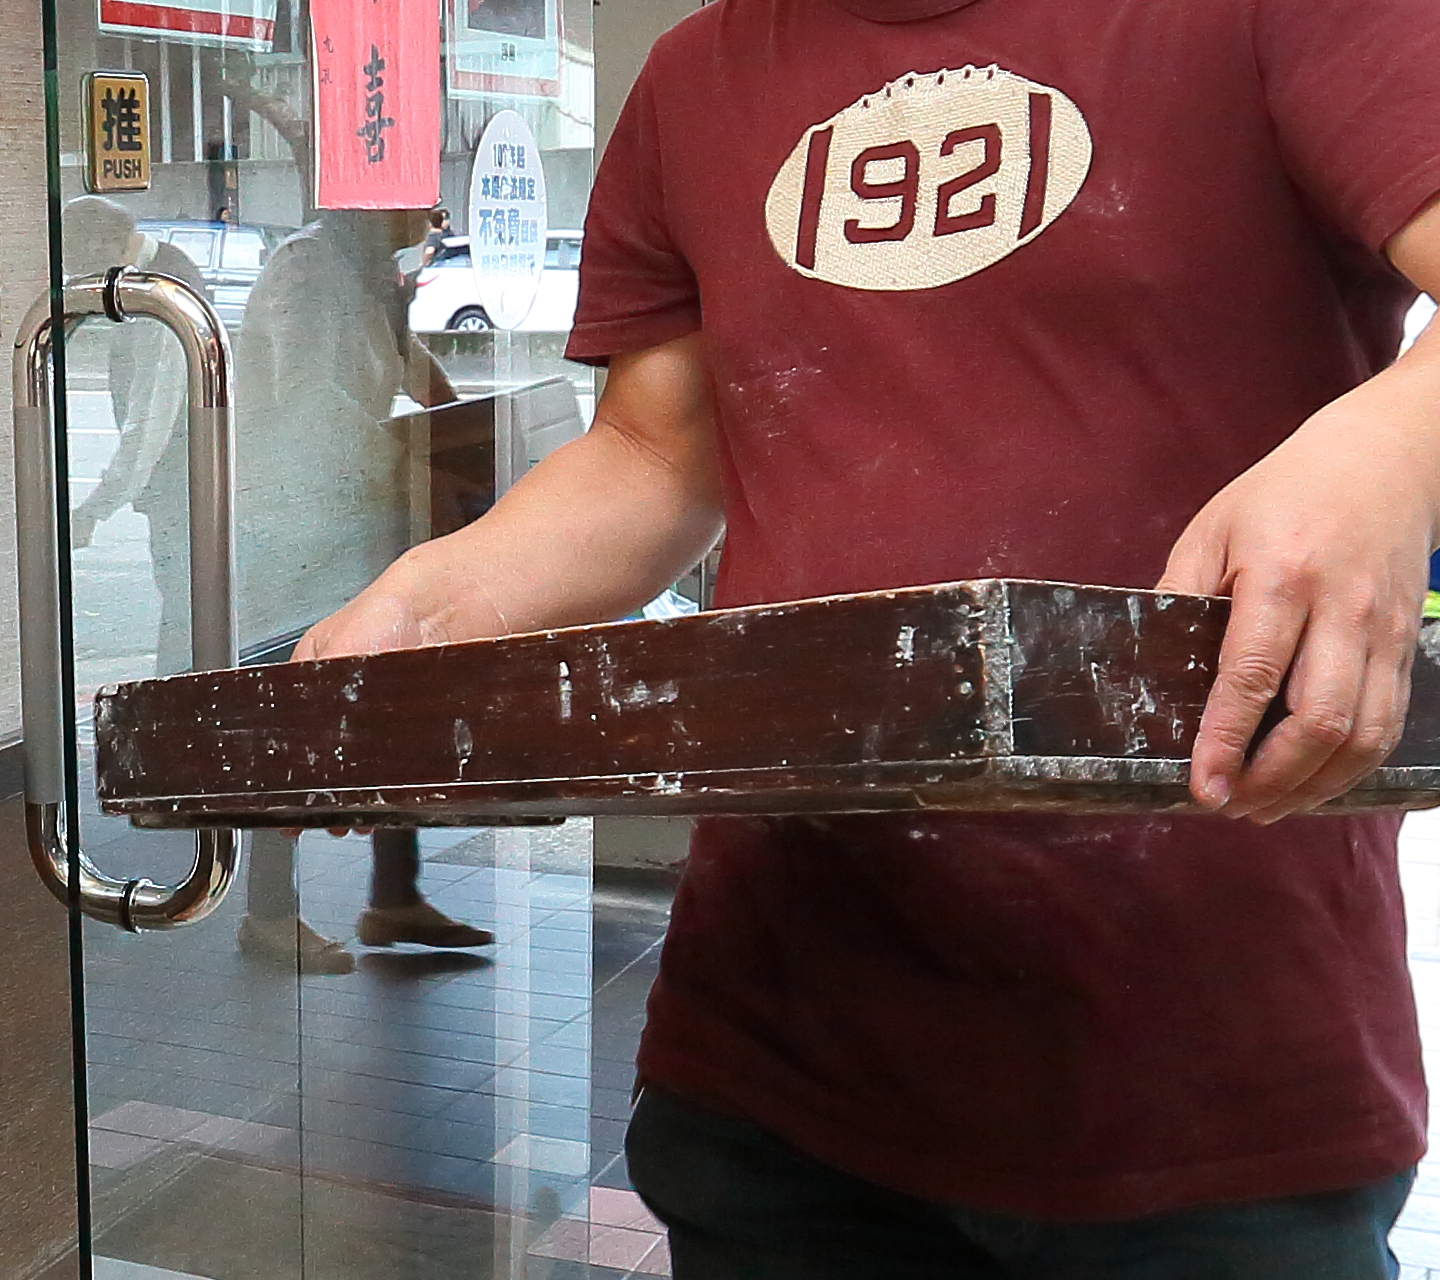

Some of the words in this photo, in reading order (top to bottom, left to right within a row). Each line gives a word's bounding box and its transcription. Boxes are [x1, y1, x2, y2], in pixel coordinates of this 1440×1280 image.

[101, 86, 143, 152] 推
[103, 158, 142, 180] PUSH
[795, 92, 1052, 271] 1921
